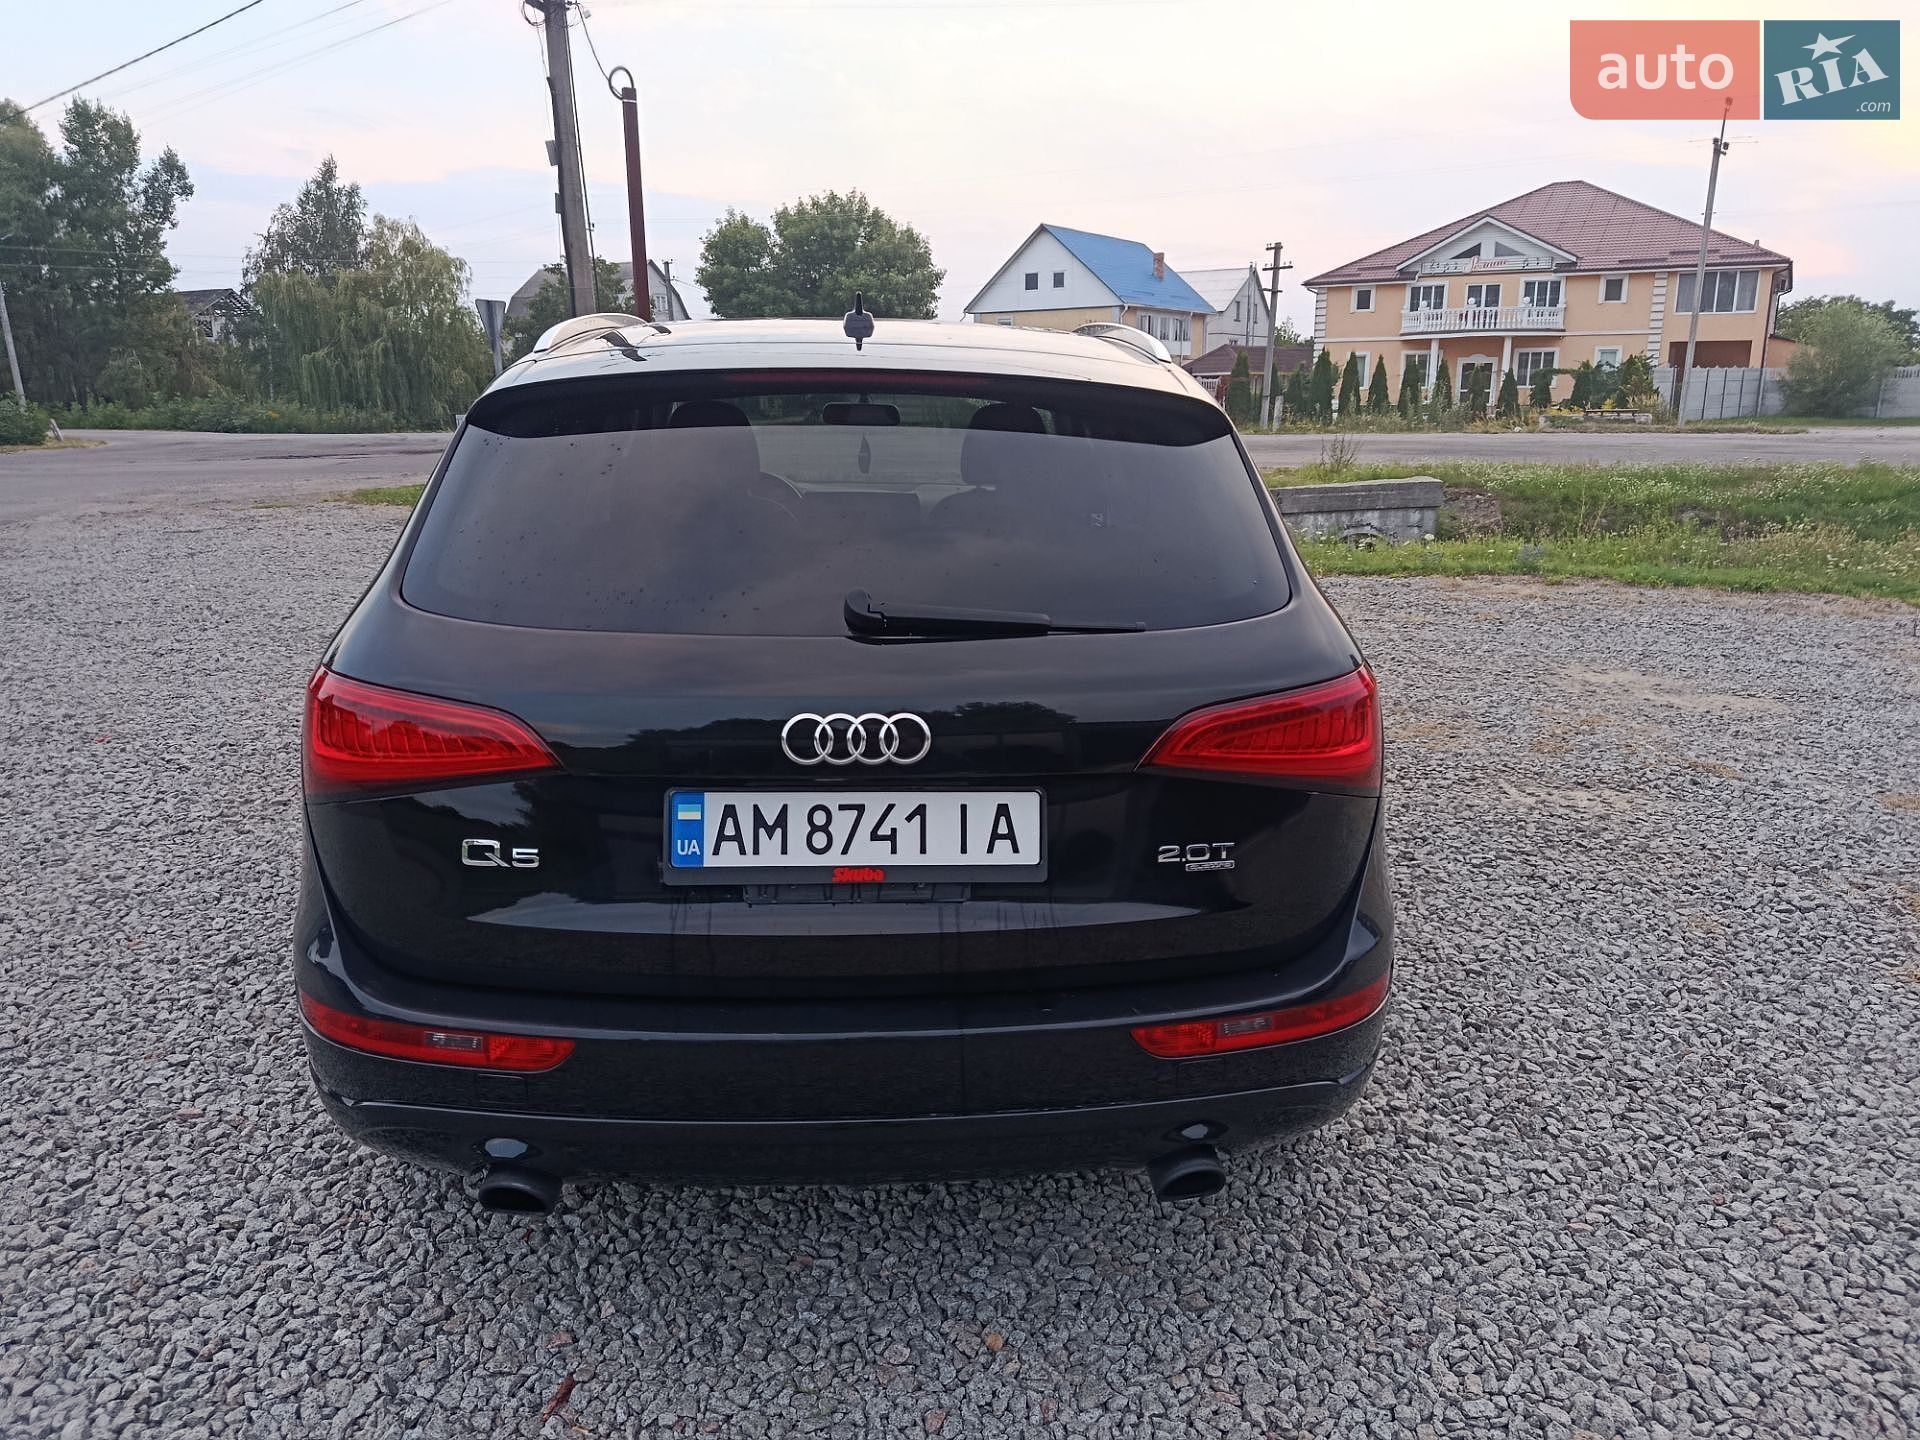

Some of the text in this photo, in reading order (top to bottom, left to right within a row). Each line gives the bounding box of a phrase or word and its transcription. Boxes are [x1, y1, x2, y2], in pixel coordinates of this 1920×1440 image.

[712, 803, 1020, 855] AM 8741 IA
[462, 838, 540, 868] Q5
[677, 839, 701, 855] UA
[1158, 842, 1235, 862] 2.0T
